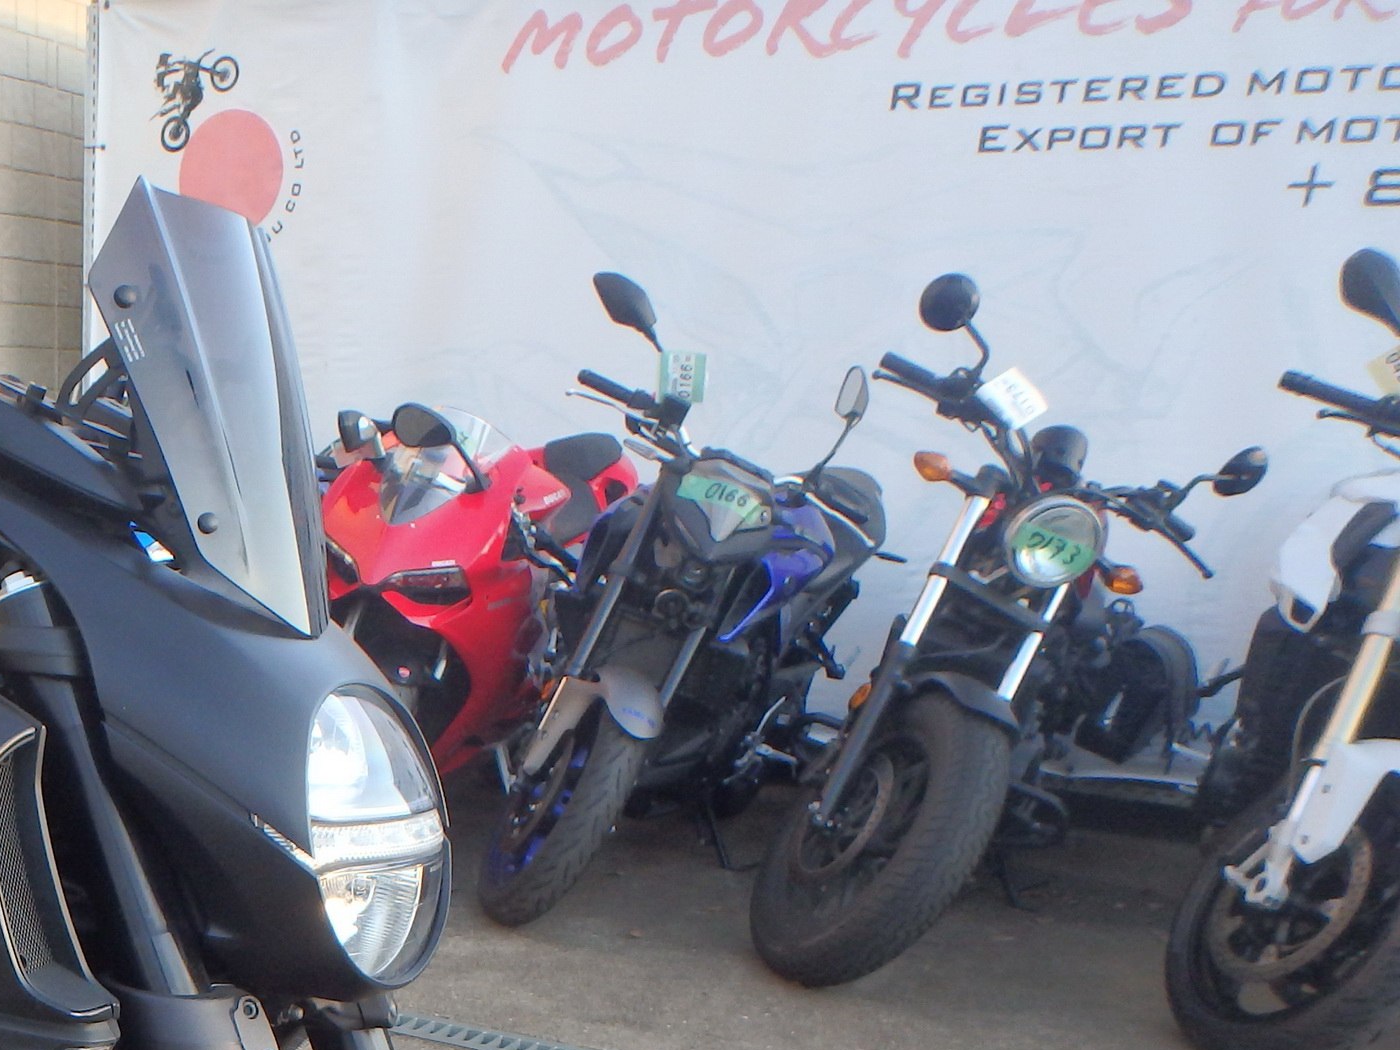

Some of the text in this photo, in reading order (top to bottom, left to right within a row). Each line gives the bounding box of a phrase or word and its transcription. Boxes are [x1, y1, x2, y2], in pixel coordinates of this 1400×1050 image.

[889, 71, 1226, 111] REGISTERED
[290, 130, 305, 168] LTD
[977, 122, 1183, 153] EXPORT
[1210, 118, 1284, 147] OF
[285, 183, 302, 212] CO
[704, 483, 749, 508] 0166
